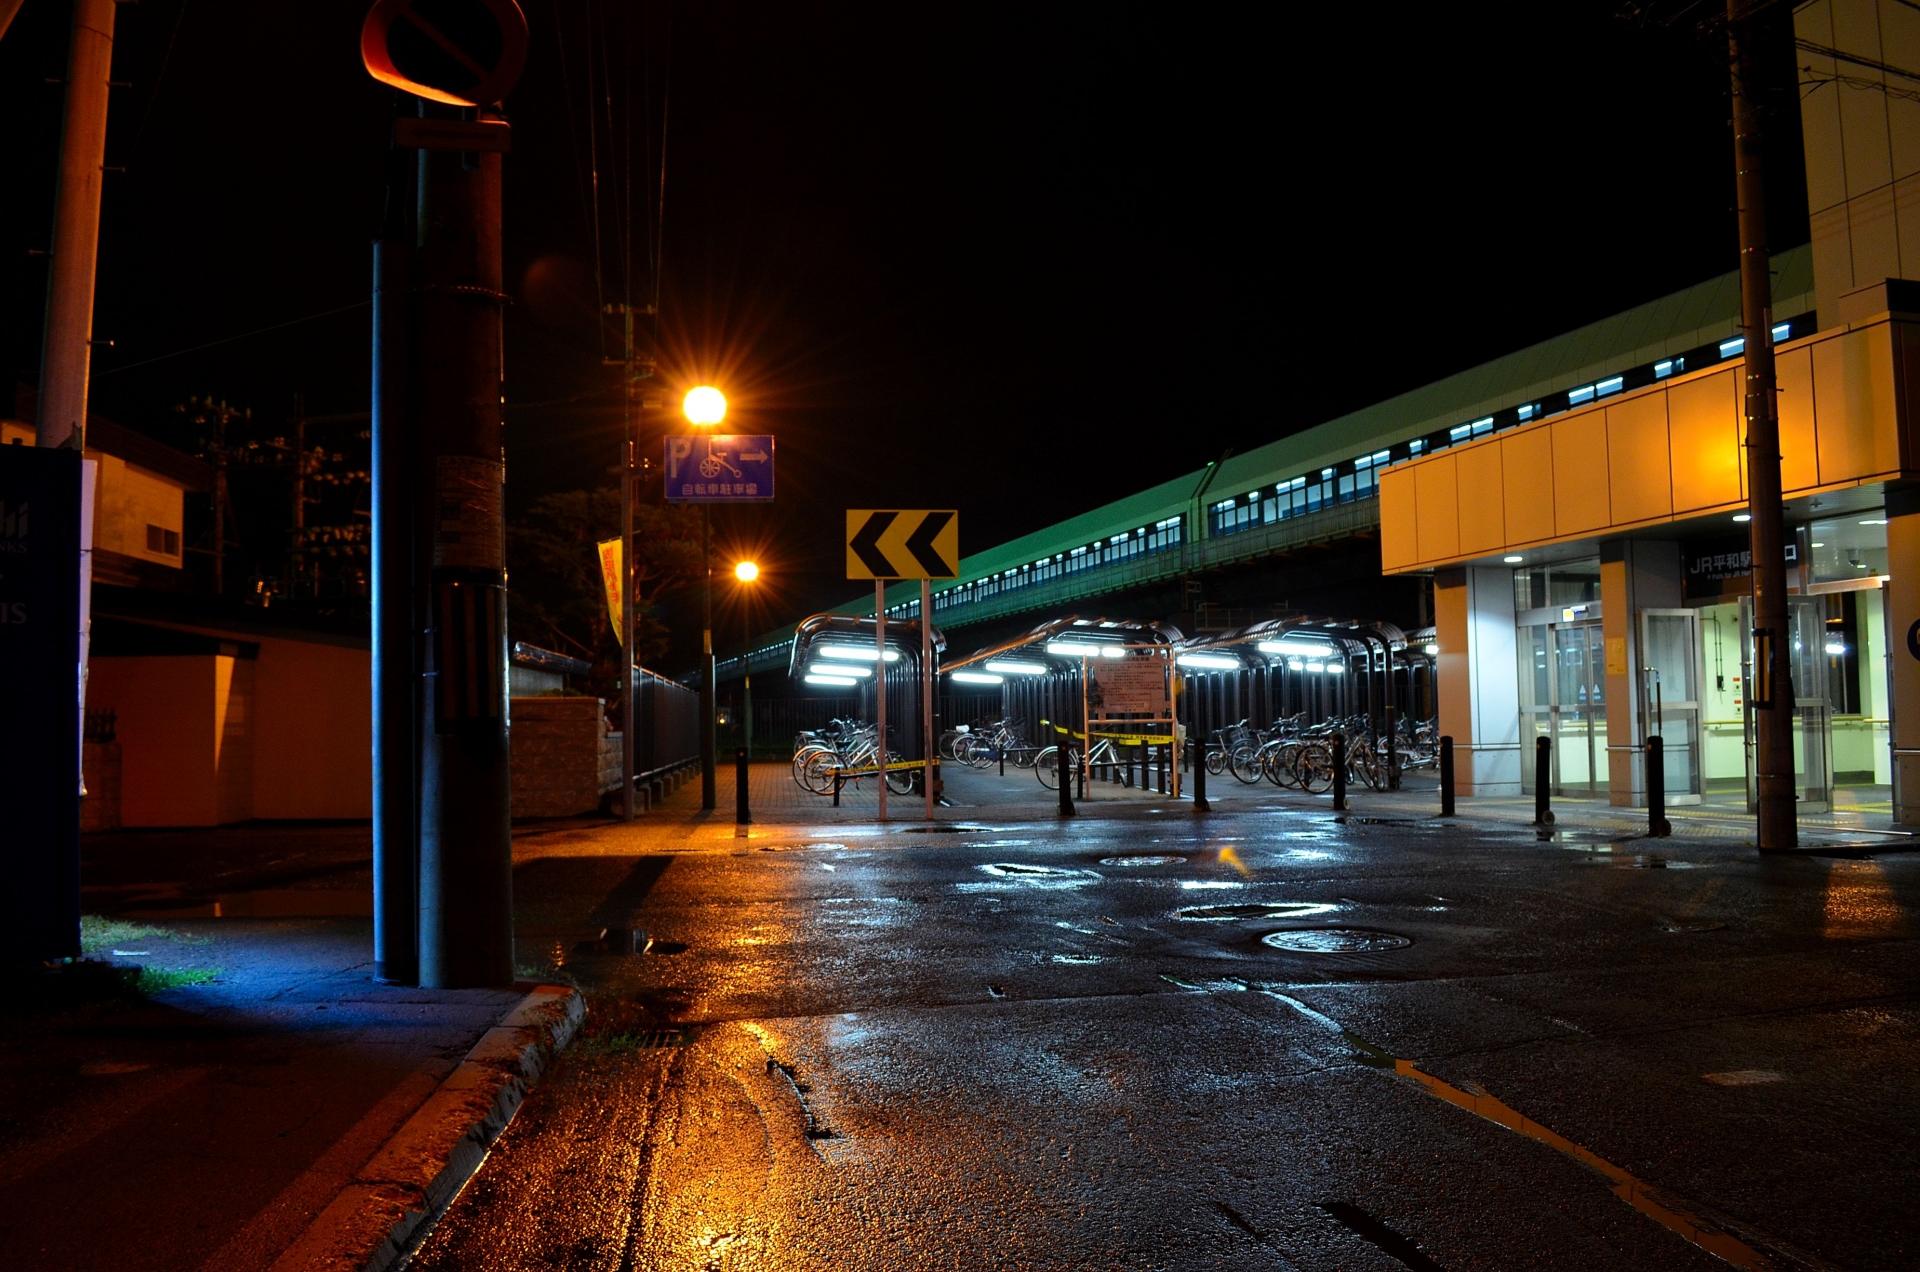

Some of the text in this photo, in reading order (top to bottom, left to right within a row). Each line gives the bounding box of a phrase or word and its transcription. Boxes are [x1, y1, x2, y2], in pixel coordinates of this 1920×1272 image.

[670, 438, 692, 479] P
[682, 482, 758, 495] 自転車駐車場
